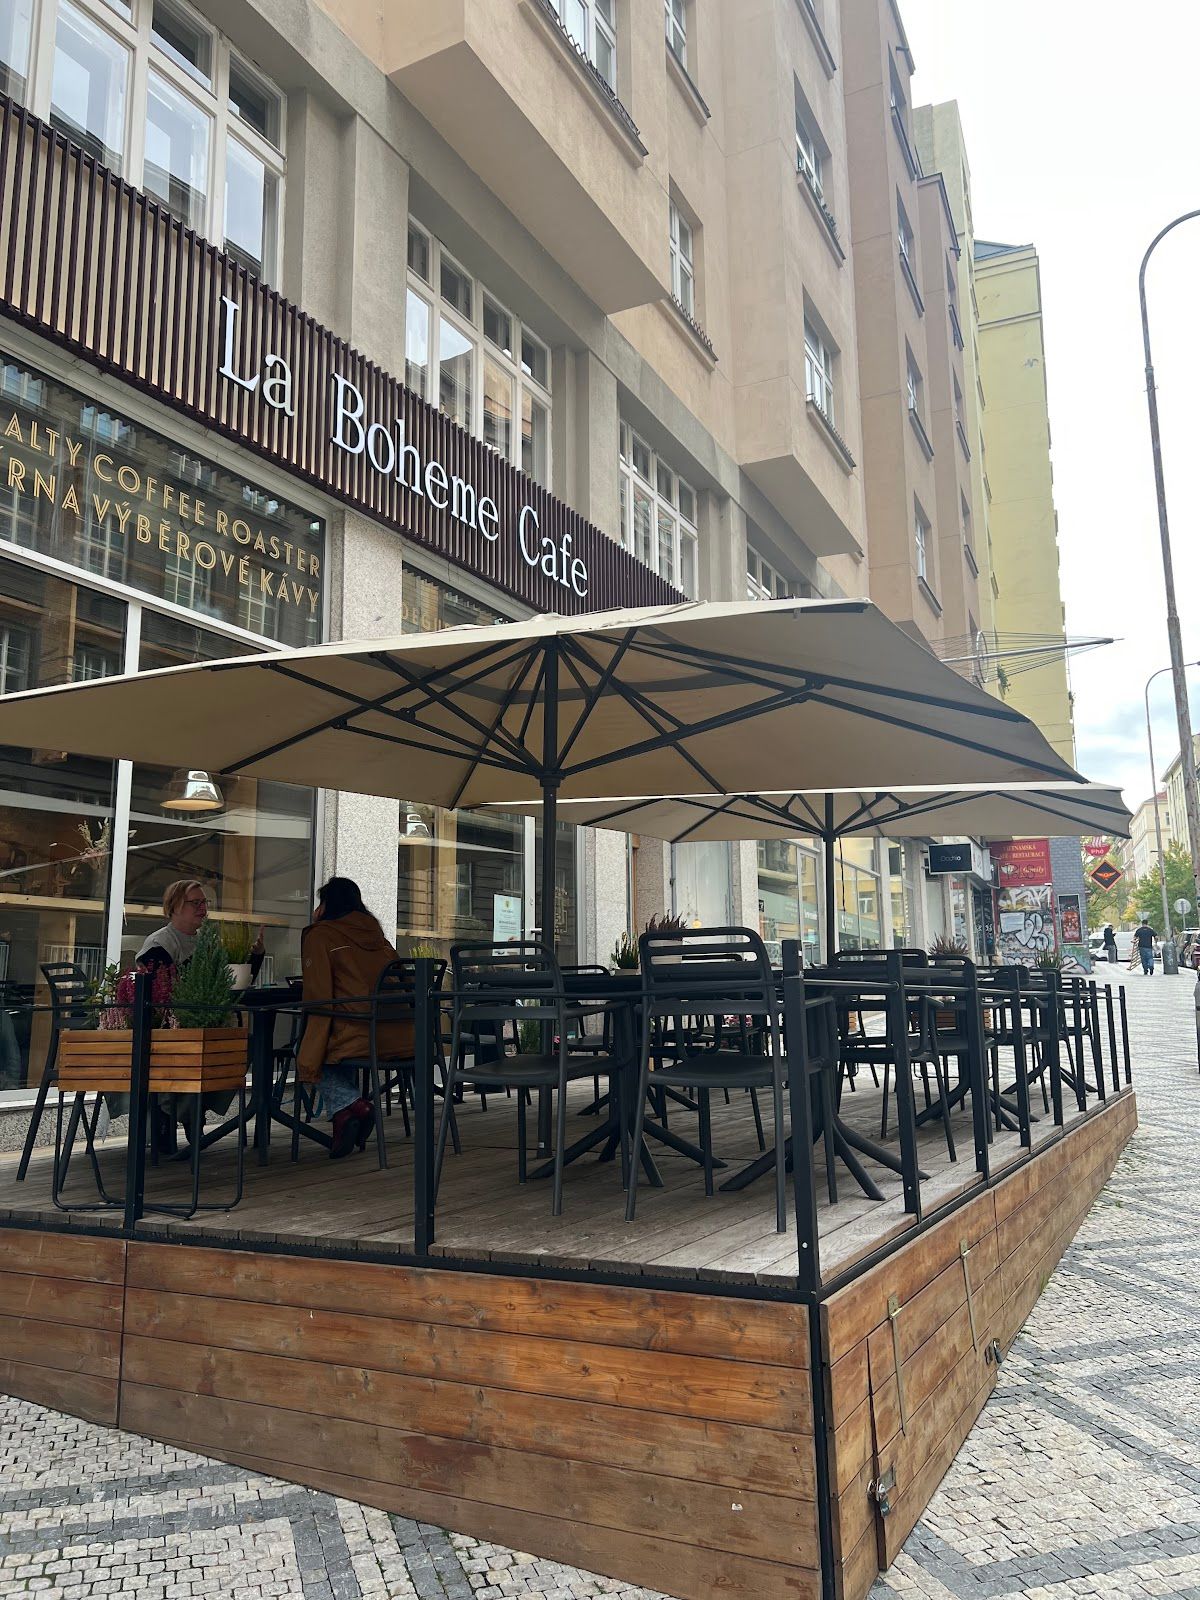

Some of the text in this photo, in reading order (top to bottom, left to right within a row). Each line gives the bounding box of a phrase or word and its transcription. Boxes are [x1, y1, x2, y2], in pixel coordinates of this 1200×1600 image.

[0, 445, 319, 613] RNA VÝBĚROVÉ KÁVY
[93, 453, 206, 527] COFFEE
[216, 509, 320, 578] ROASTER
[218, 295, 589, 597] La Boheme Cafe
